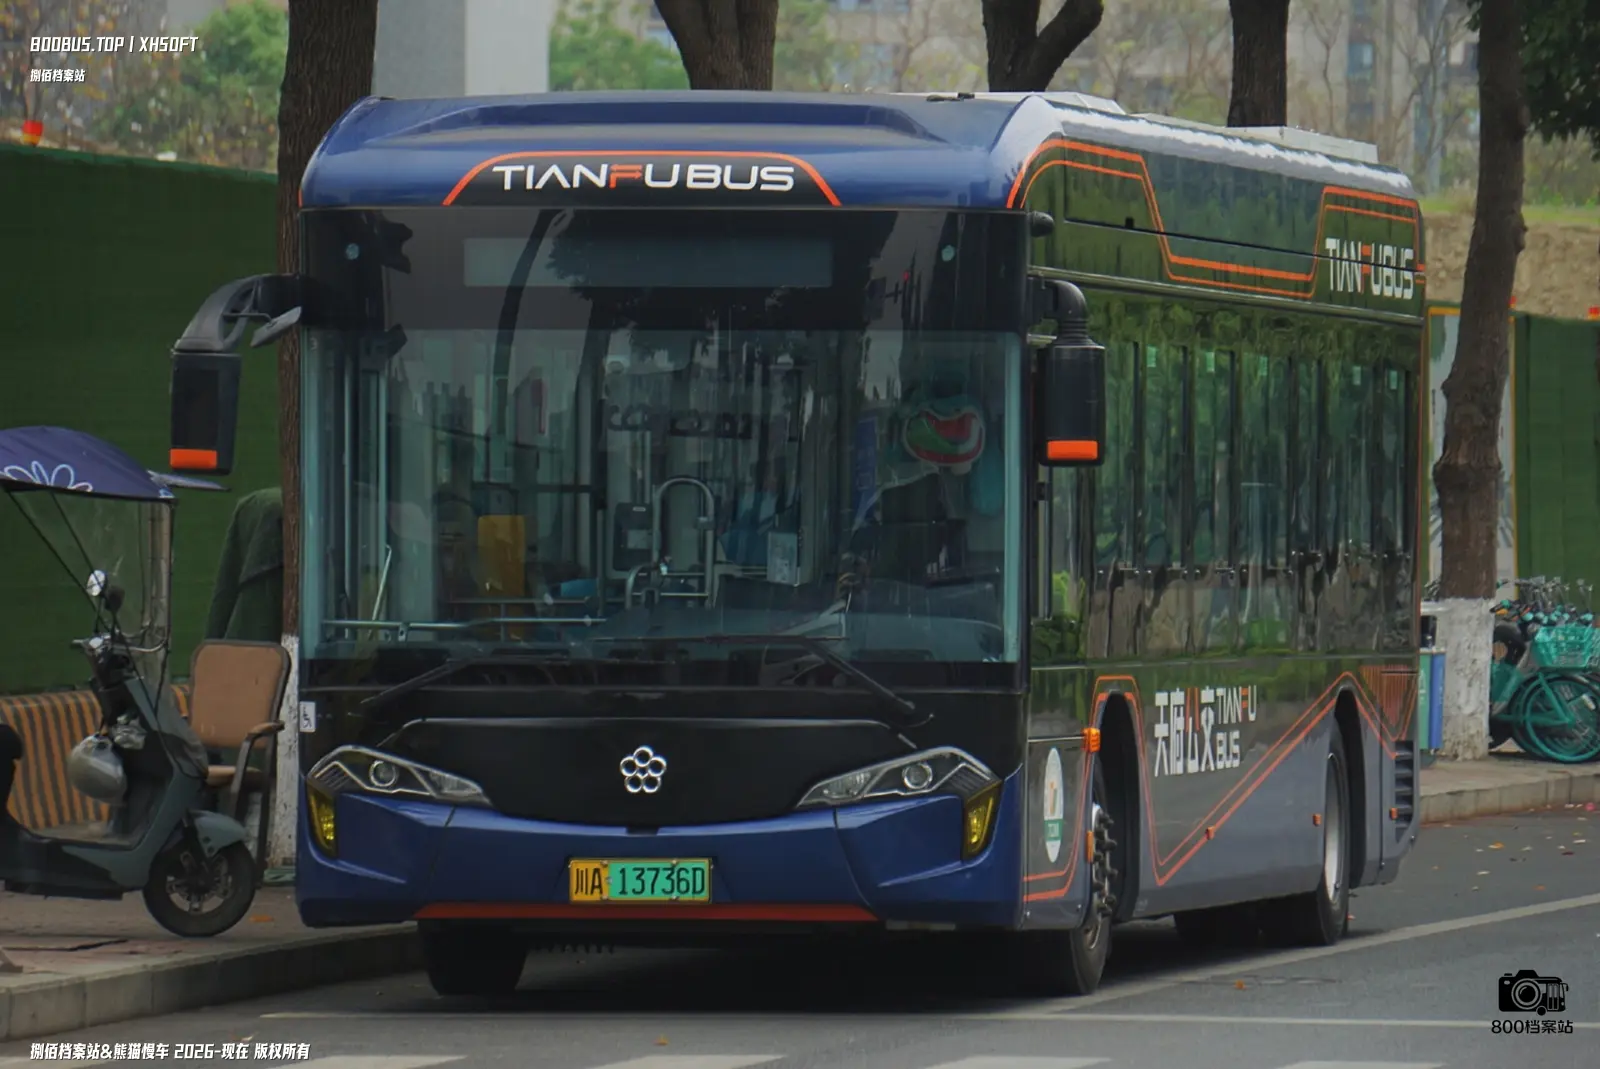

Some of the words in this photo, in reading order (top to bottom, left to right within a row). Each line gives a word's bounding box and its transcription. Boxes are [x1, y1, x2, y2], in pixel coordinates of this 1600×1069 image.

[492, 163, 680, 190] TIANFU
[686, 164, 795, 191] BUS
[1154, 685, 1215, 777] 天府公交
[1216, 730, 1240, 770] BUS
